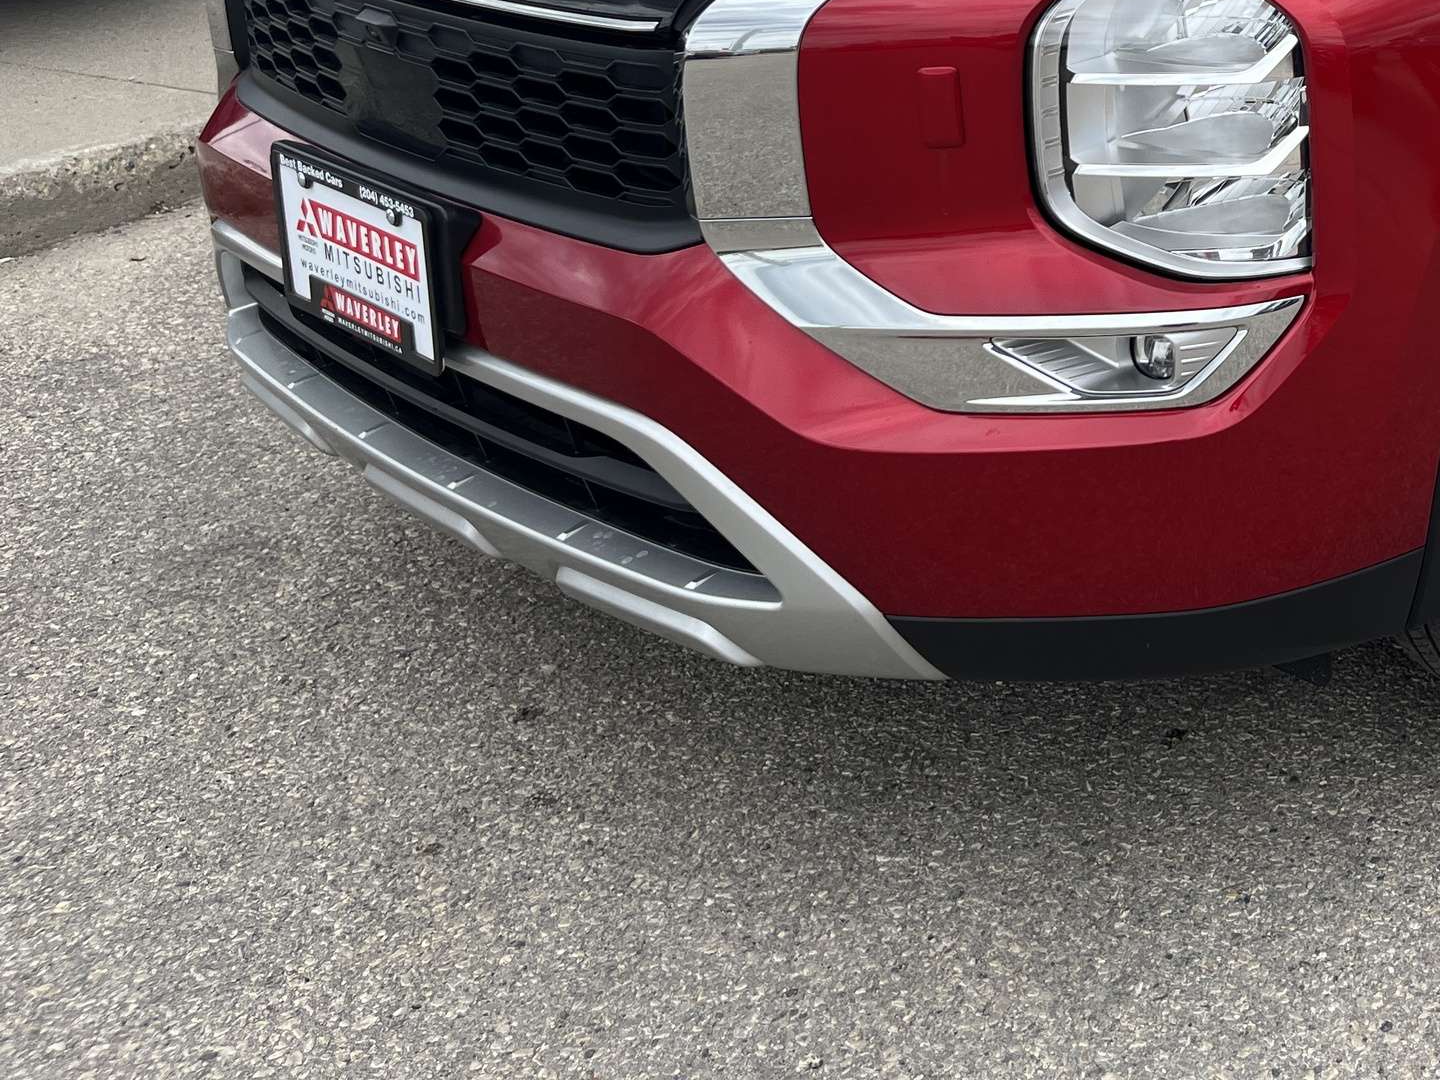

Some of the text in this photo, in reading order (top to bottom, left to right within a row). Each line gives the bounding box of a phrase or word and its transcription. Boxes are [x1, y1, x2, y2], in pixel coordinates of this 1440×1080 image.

[280, 153, 343, 188] Best Backed Cars
[359, 185, 415, 218] (204) 453-5453
[317, 207, 416, 275] WAVERLEY
[300, 258, 425, 324] waverleymitsubishi.com
[324, 242, 421, 304] MITSUBISHI
[335, 291, 400, 338] WAVERLEY
